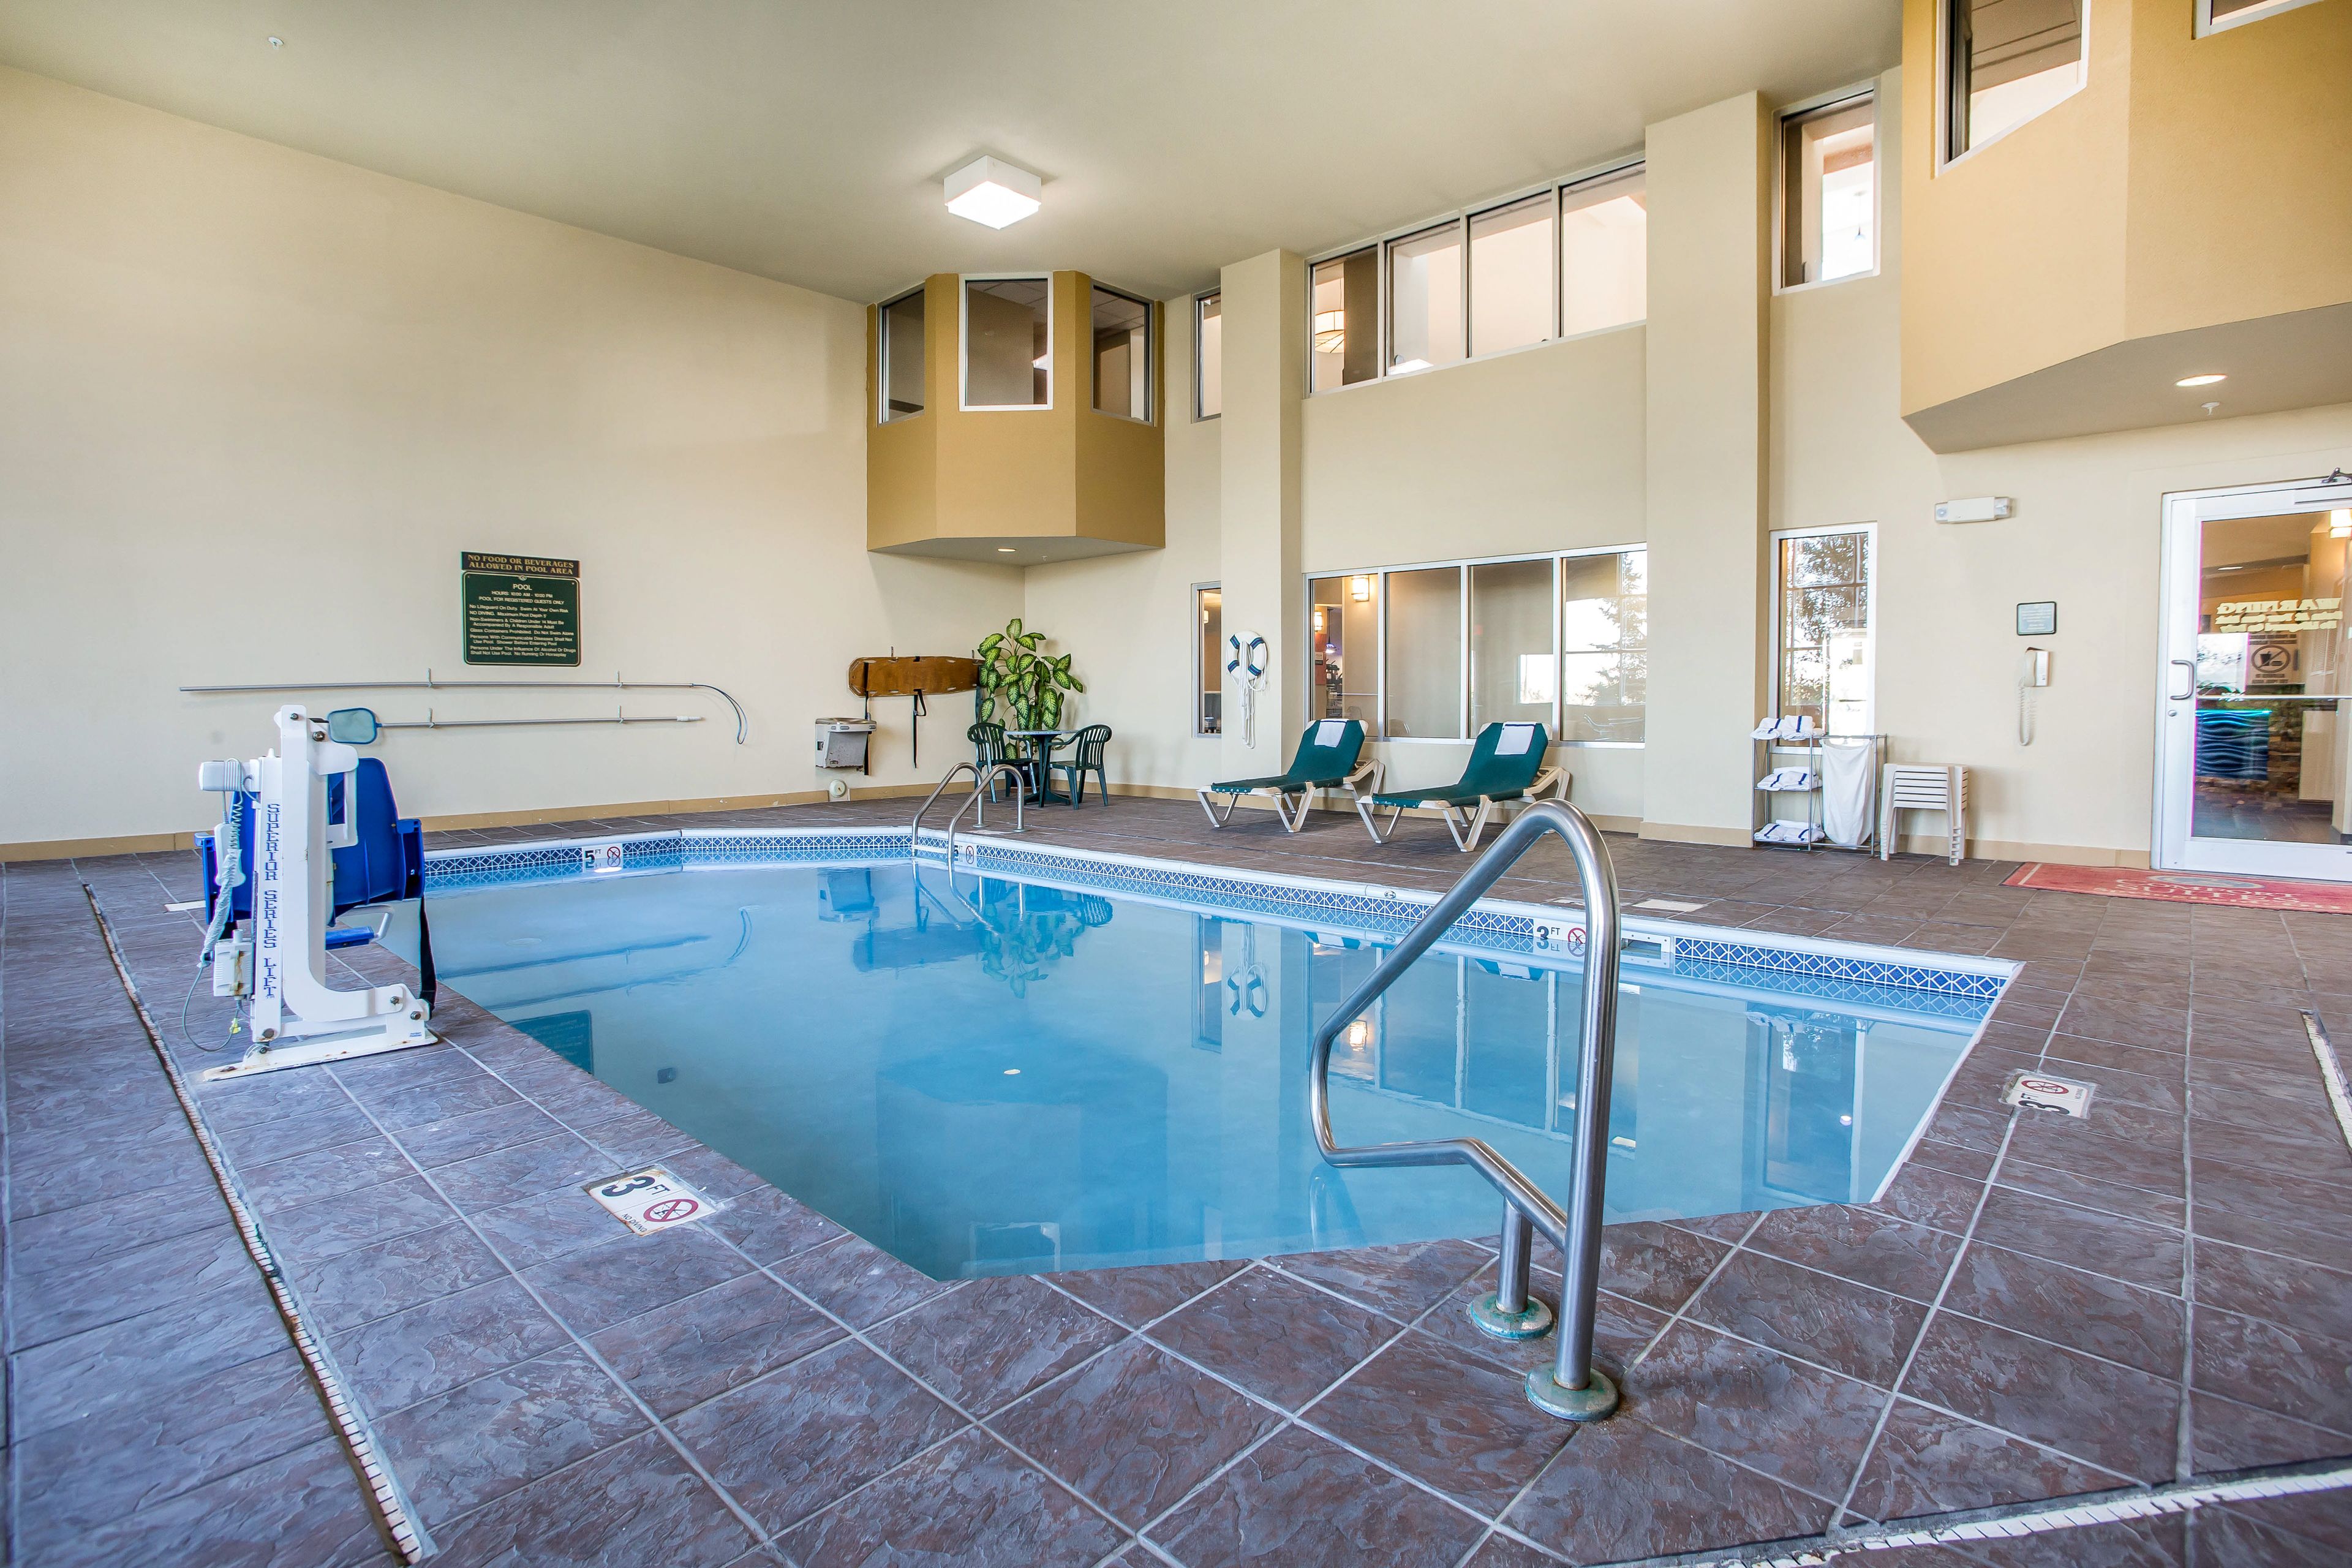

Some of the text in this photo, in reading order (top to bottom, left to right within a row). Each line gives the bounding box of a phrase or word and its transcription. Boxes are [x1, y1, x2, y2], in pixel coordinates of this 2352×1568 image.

[469, 562, 512, 570] ALLOWED
[524, 559, 574, 568] BEVERAGES
[265, 803, 281, 881] SUPERIOR
[2115, 884, 2301, 903] SUITES
[2116, 879, 2301, 897] COMFORT
[263, 890, 277, 949] SERIES
[1536, 925, 1561, 940] 3 FT
[263, 957, 277, 996] LIFT
[601, 1175, 671, 1197] 3 FT
[628, 1219, 647, 1232] DIVING
